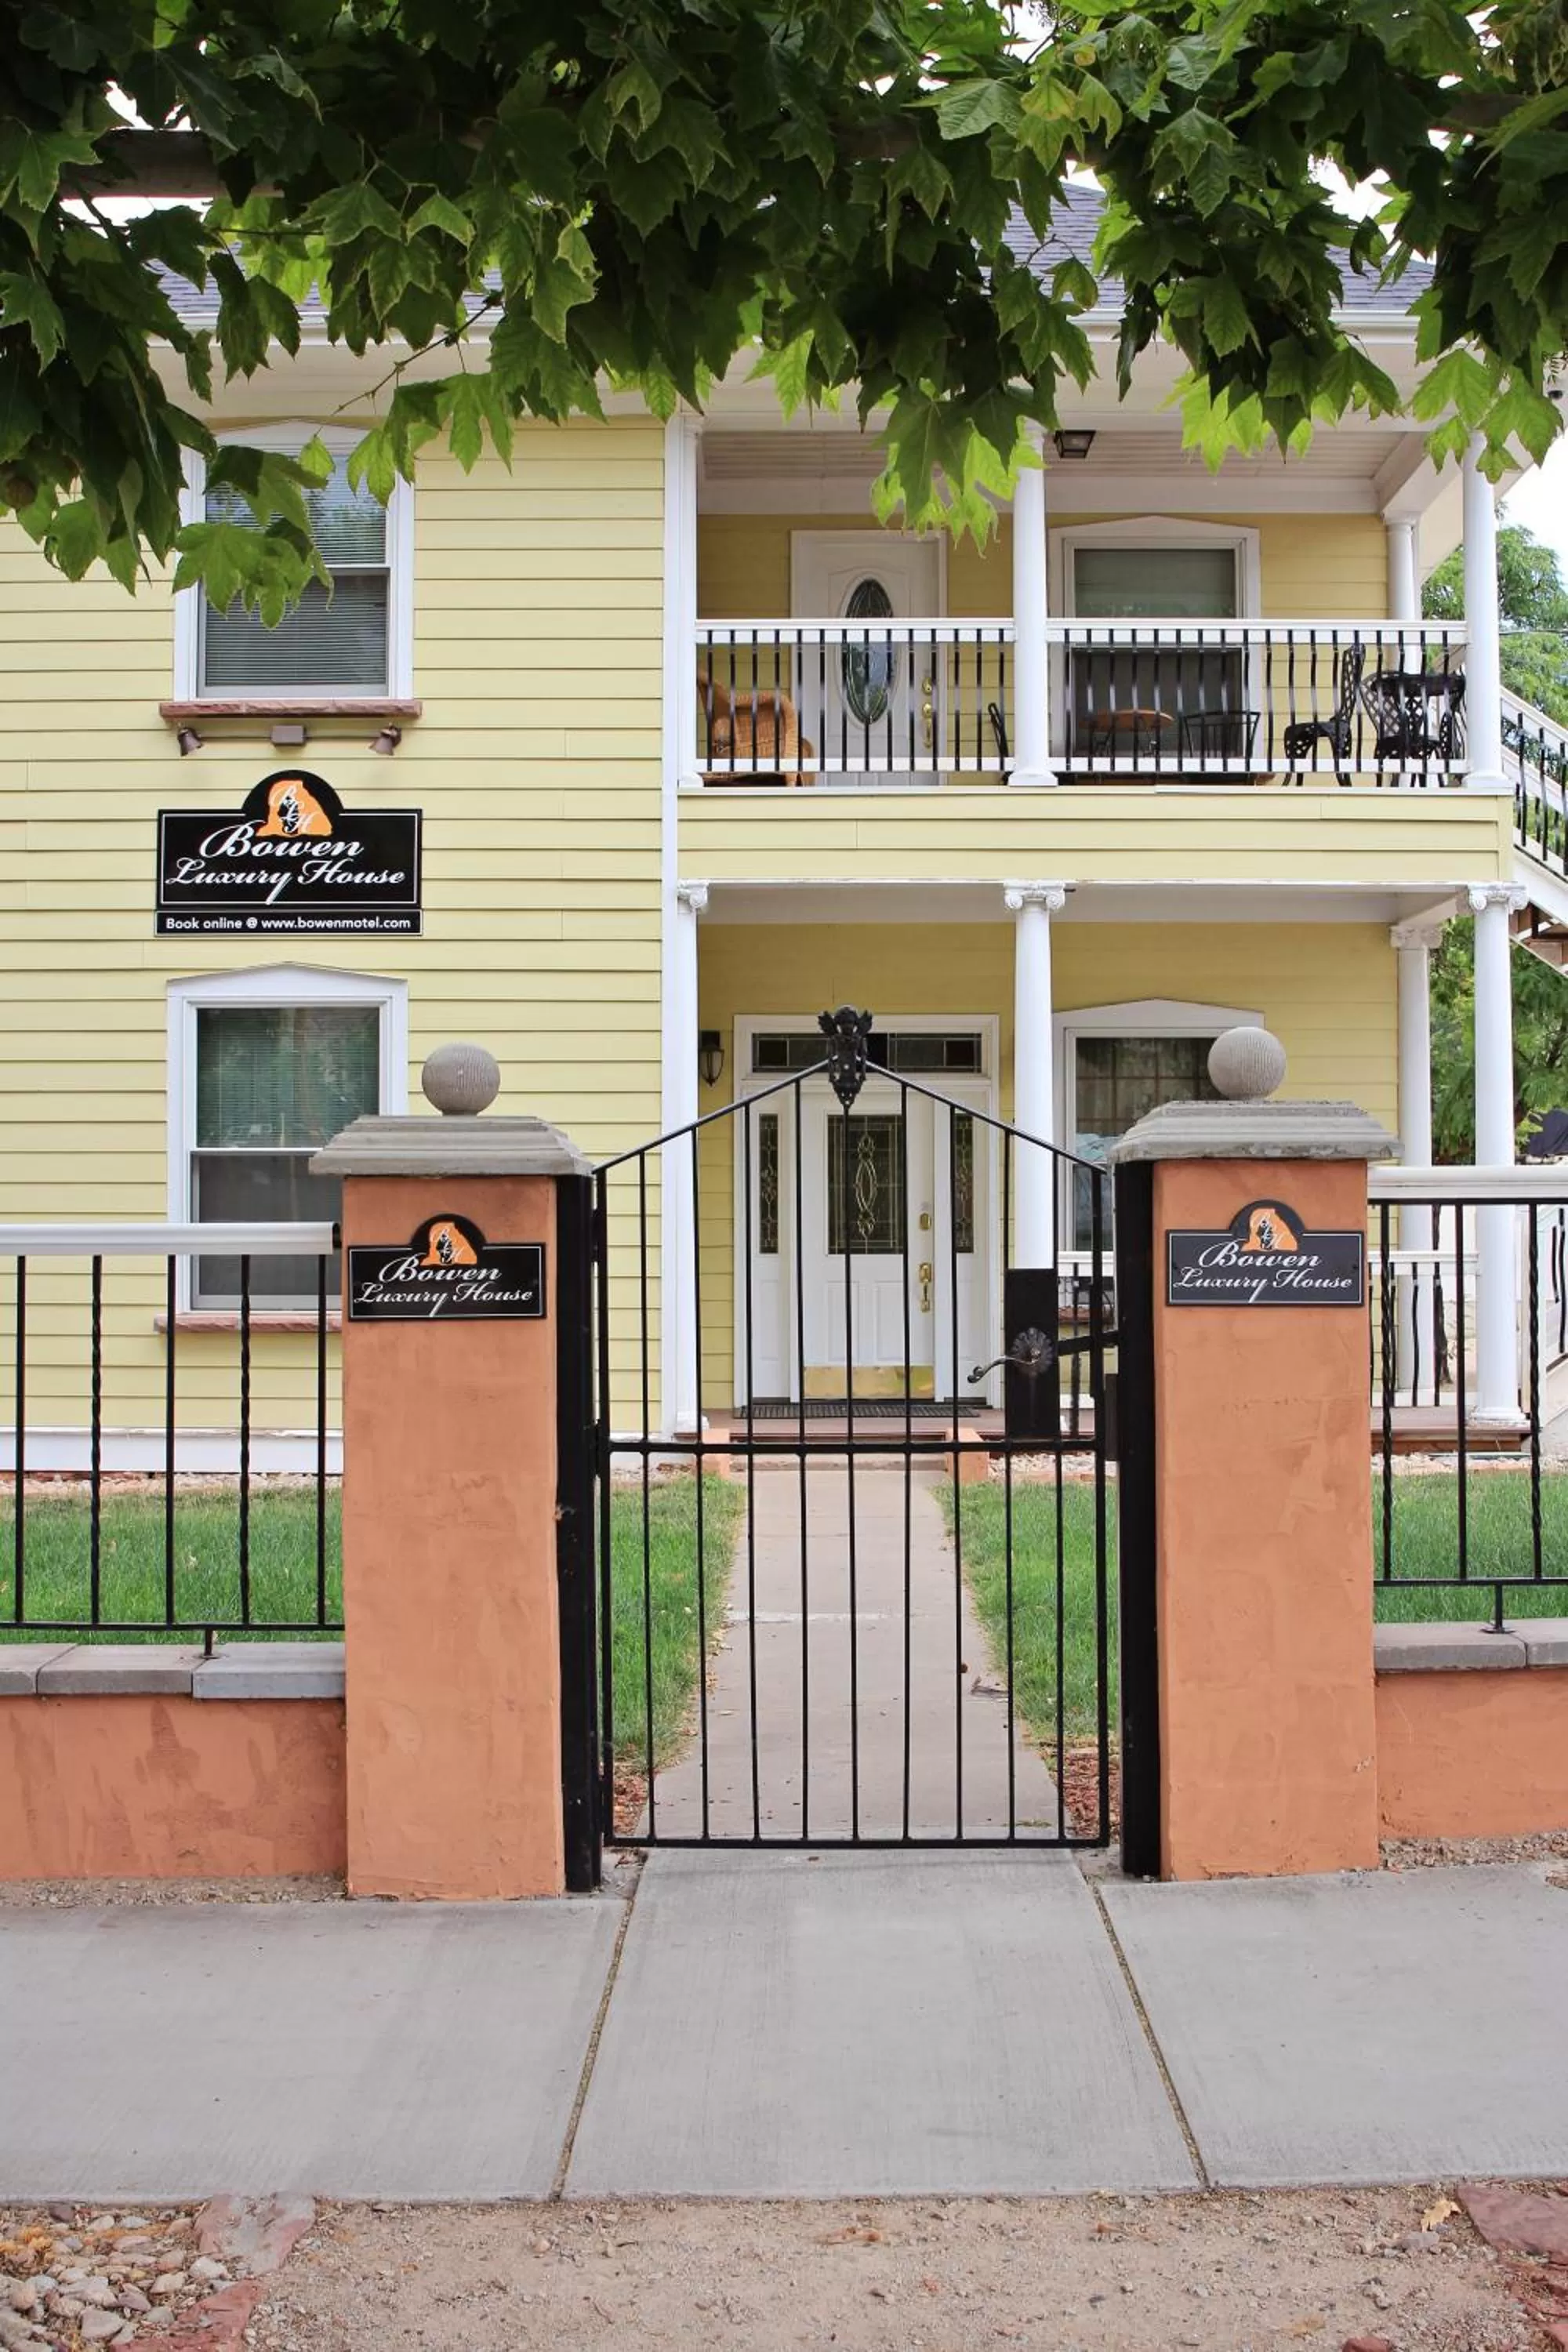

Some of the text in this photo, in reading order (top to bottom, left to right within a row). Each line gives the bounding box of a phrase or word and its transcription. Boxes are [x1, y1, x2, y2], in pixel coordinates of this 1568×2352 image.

[199, 820, 364, 858] Bowen
[165, 857, 406, 905] Luxury House
[165, 916, 411, 929] Book online @ www.bowenmotel.com
[379, 1251, 503, 1283] Bowen
[1198, 1238, 1323, 1268] Bowen
[354, 1281, 533, 1317] Luxury House
[1172, 1266, 1353, 1303] Luxury House
